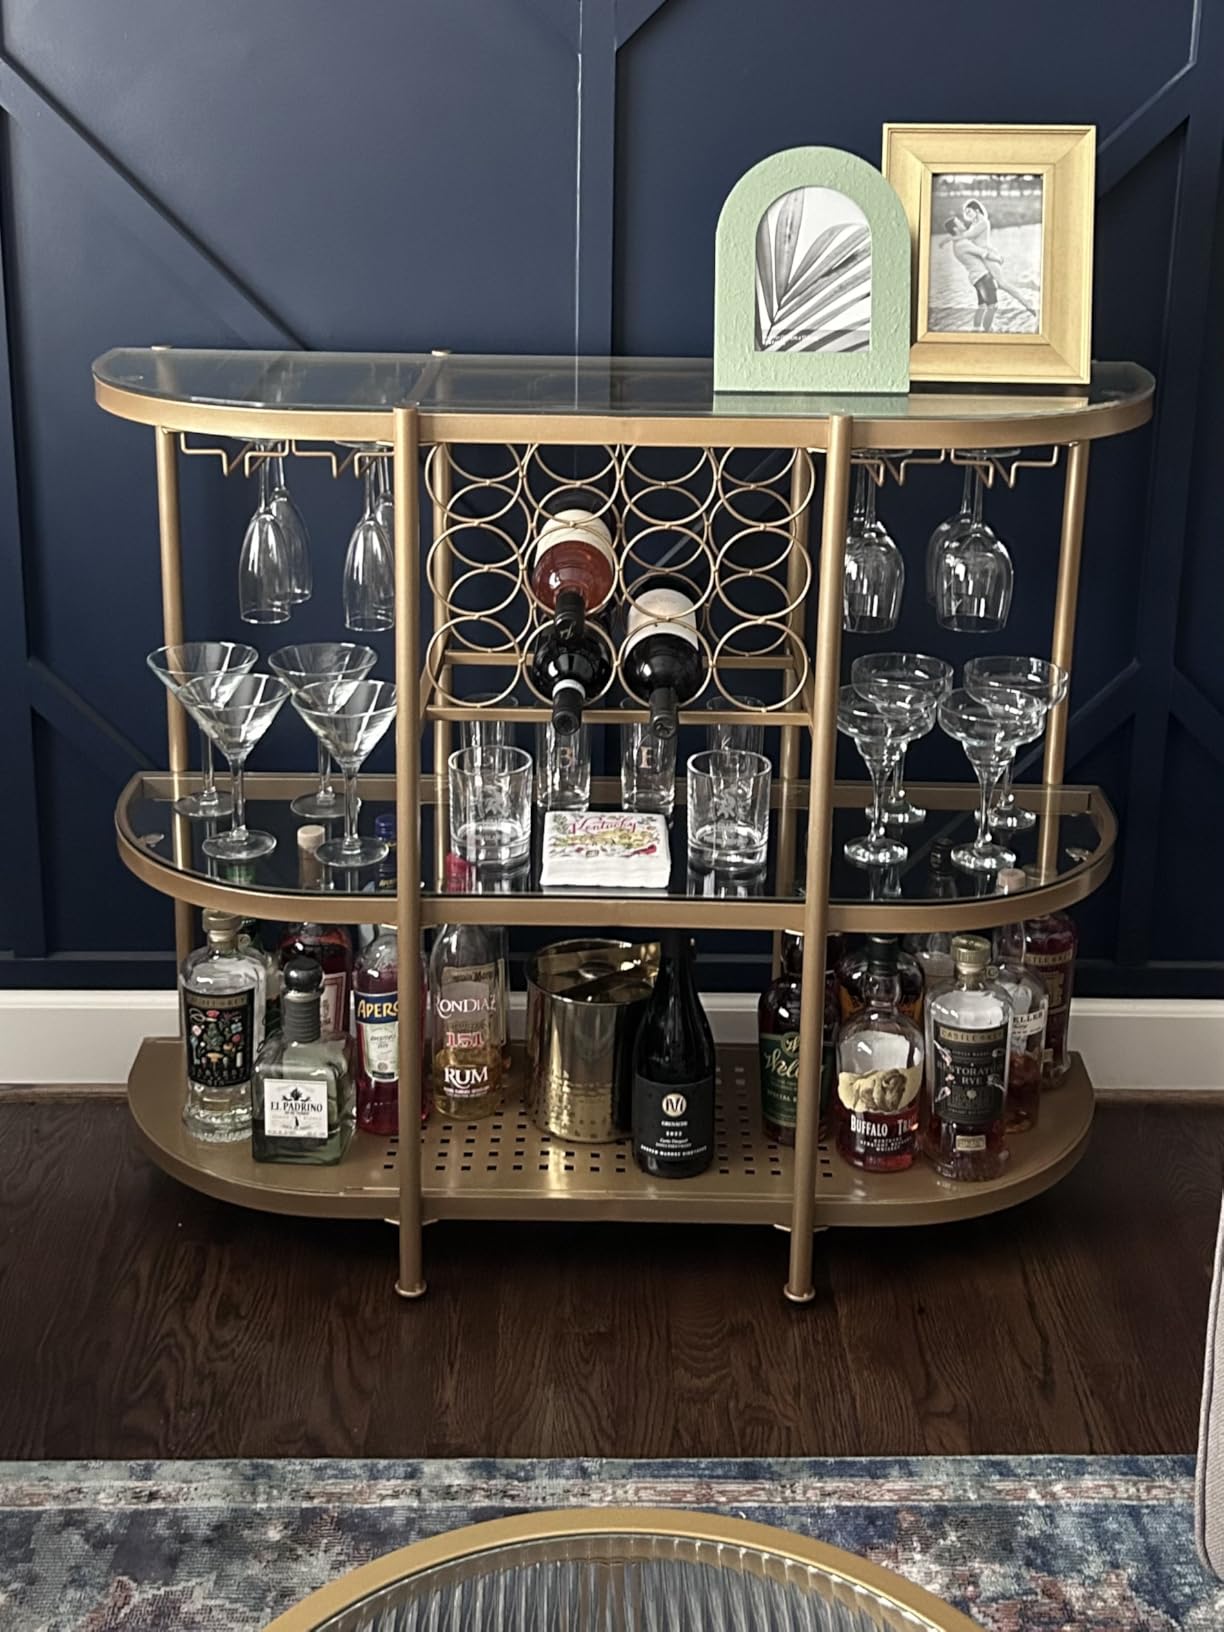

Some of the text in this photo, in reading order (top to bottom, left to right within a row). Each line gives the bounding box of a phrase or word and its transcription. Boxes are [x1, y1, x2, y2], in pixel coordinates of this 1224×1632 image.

[444, 1066, 488, 1089] RUM
[283, 1102, 323, 1113] PADRINO
[850, 1114, 888, 1137] BUFFALO
